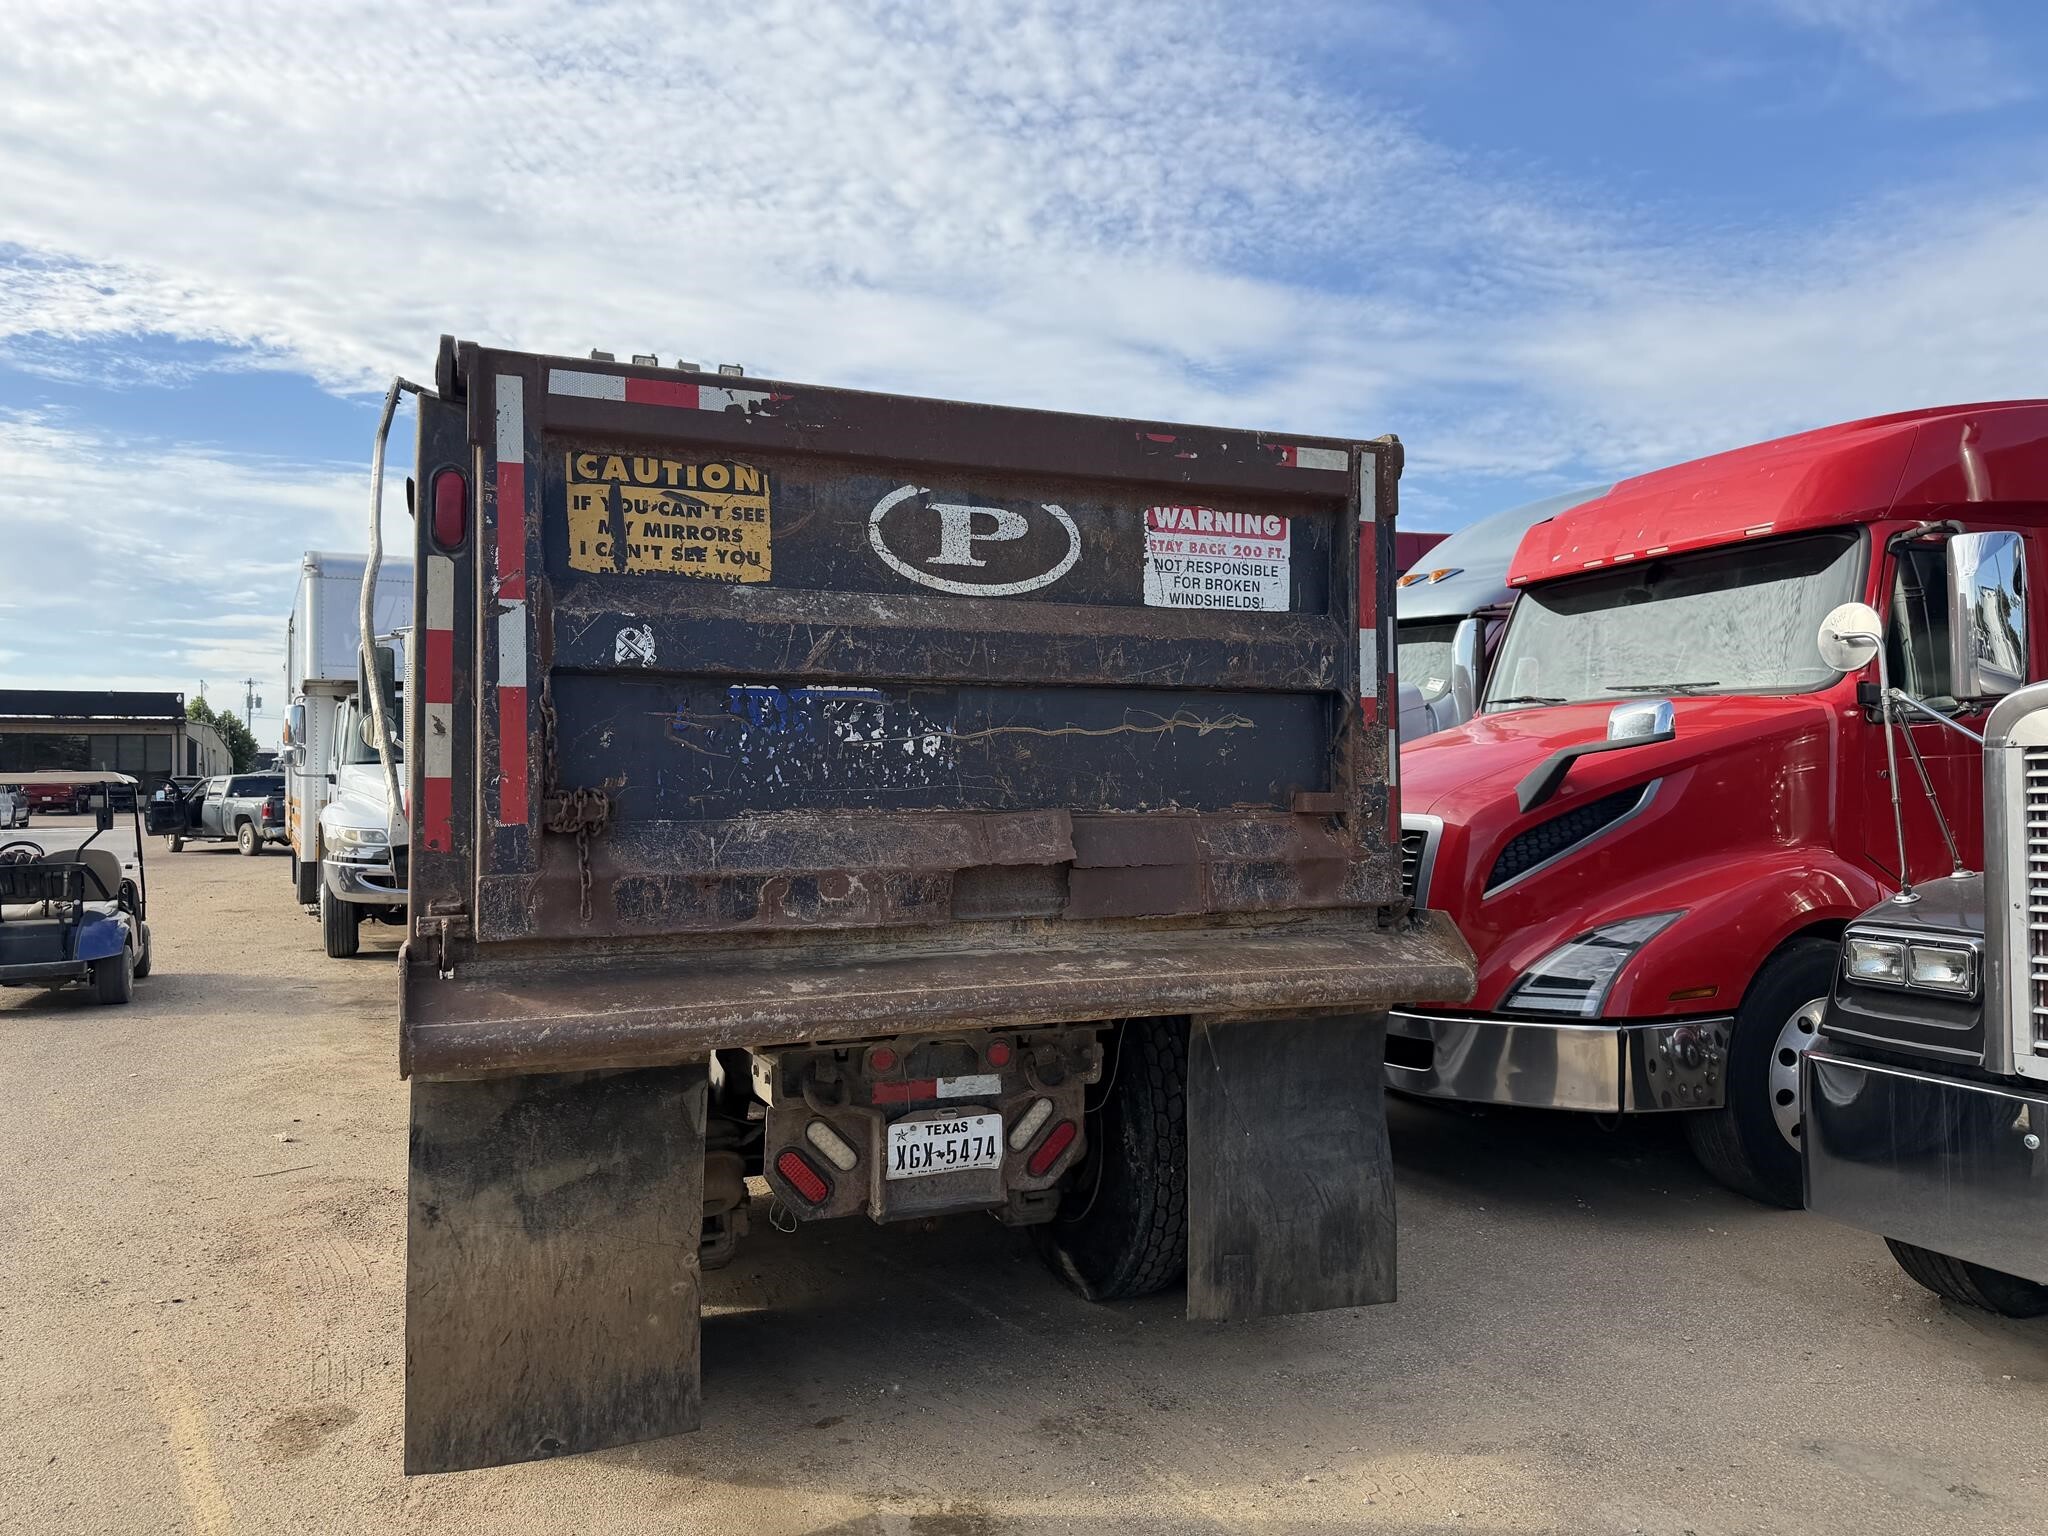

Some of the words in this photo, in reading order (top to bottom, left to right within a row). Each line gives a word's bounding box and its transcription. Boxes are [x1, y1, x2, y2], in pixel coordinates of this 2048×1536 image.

[576, 453, 760, 493] CAUTION
[573, 495, 591, 511] IF
[658, 501, 724, 520] CAN'T
[731, 506, 765, 523] SEE
[1153, 506, 1282, 537] WARNING
[642, 522, 744, 543] MIRRORS
[580, 540, 587, 556] I
[671, 546, 708, 563] SEE
[715, 548, 761, 567] YOU
[1150, 539, 1184, 554] STAY
[1189, 542, 1227, 556] BACK
[1233, 544, 1263, 558] 200
[1267, 547, 1286, 560] FT.
[1154, 558, 1182, 572] NOT
[1186, 560, 1279, 578] RESPONSIBLE
[1173, 576, 1200, 589] FOR
[1205, 578, 1261, 593] BROKEN
[1169, 592, 1265, 610] WINDSHIELDS!
[925, 1121, 969, 1136] TEXAS
[946, 1135, 996, 1164] 5474
